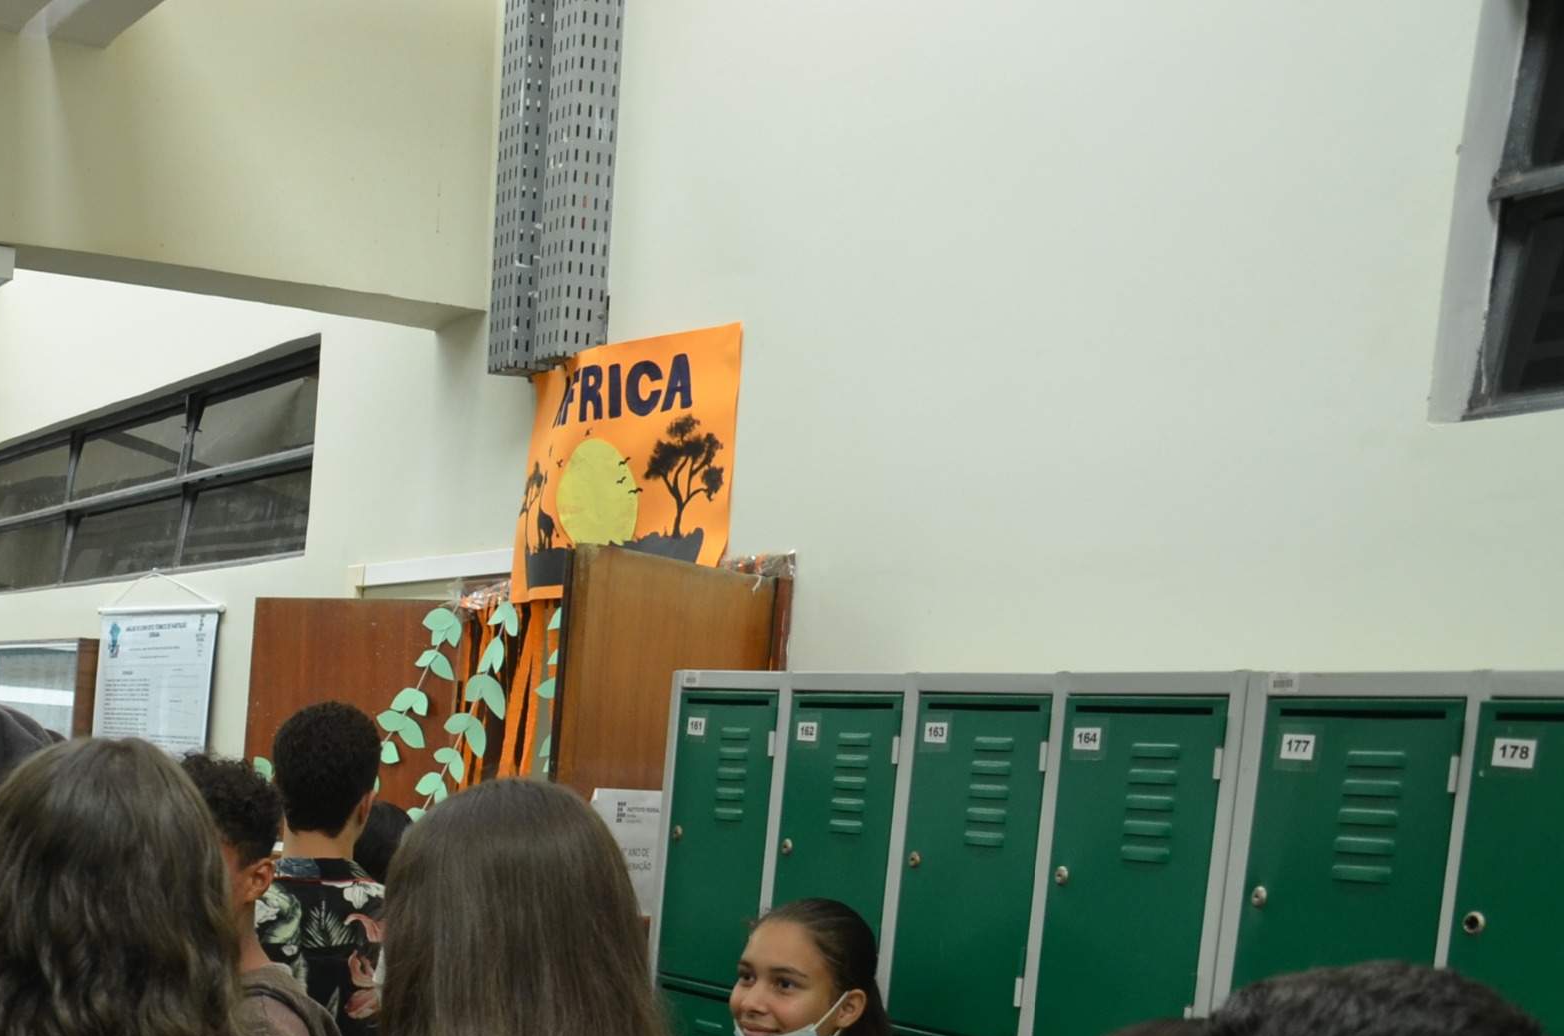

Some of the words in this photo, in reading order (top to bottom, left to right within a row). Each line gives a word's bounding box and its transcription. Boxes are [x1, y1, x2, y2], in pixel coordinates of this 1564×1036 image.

[690, 720, 703, 731] 161
[800, 726, 815, 737] 162
[928, 726, 945, 738] 163
[1077, 732, 1098, 744] 164
[1286, 739, 1311, 753] 177
[1499, 744, 1530, 760] 178
[628, 861, 651, 871] ERAÇÃO
